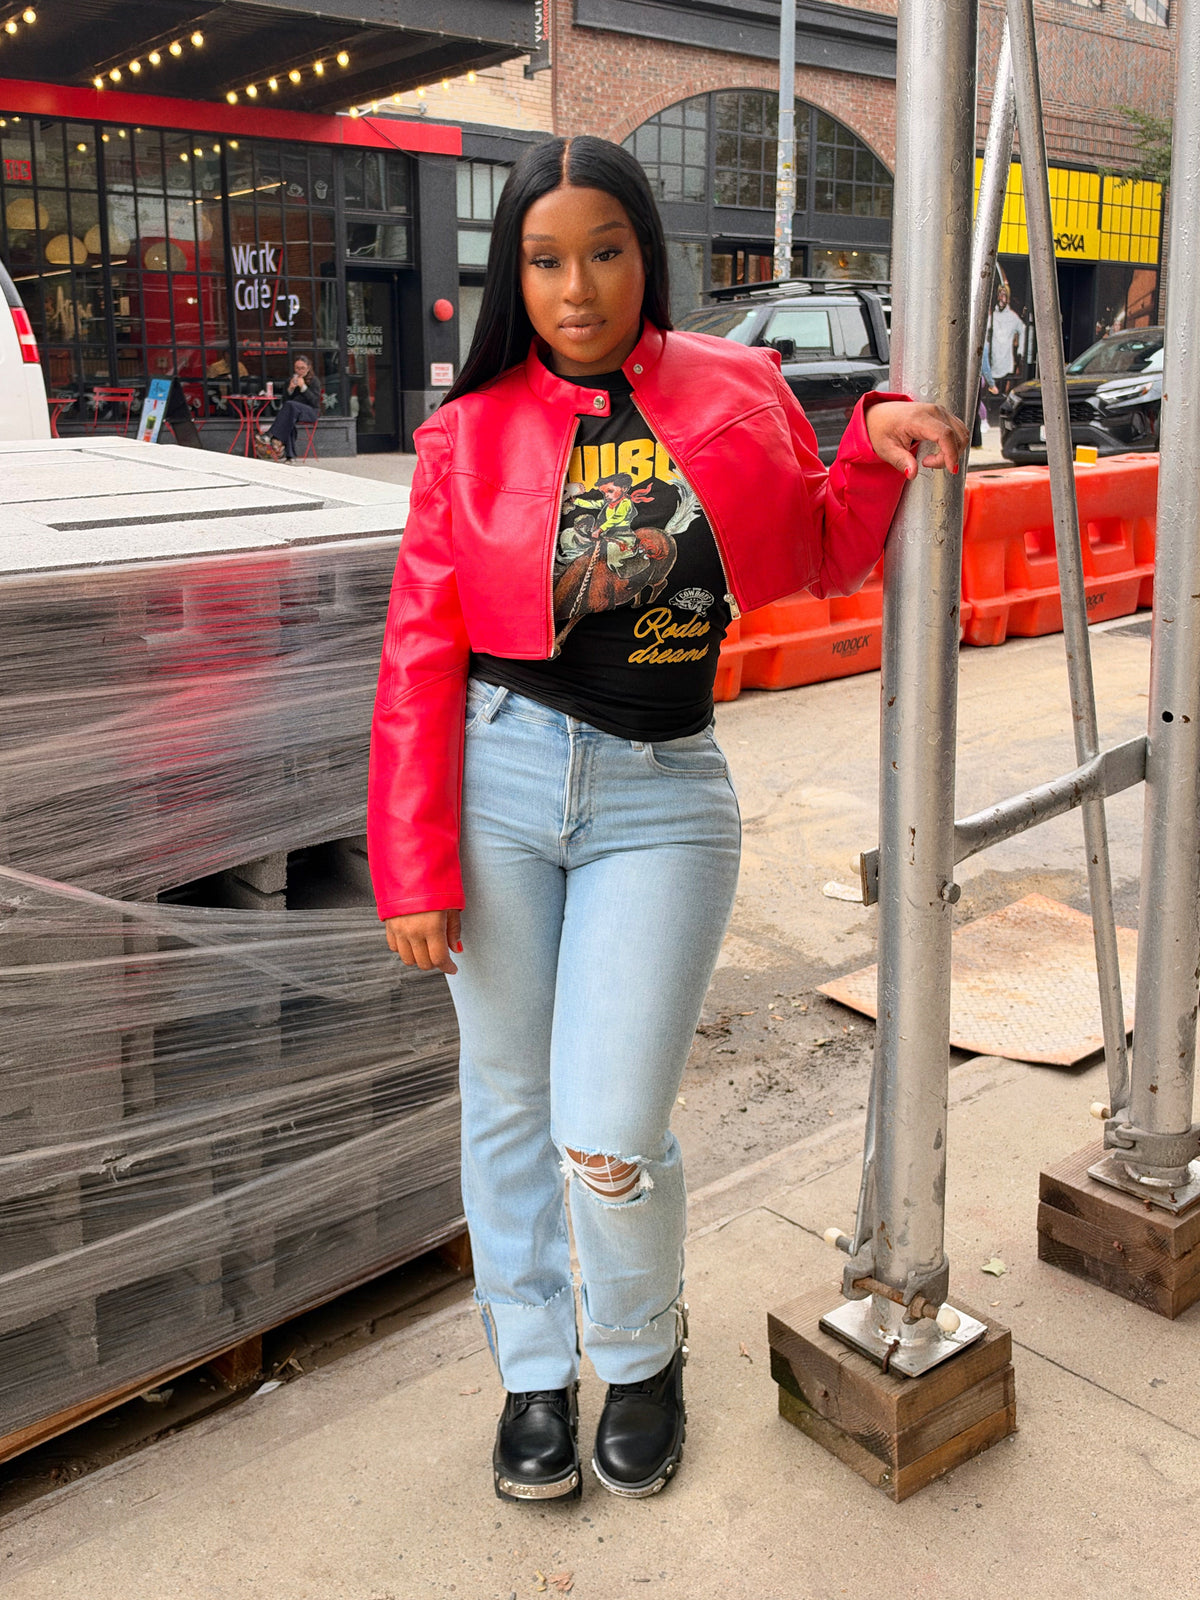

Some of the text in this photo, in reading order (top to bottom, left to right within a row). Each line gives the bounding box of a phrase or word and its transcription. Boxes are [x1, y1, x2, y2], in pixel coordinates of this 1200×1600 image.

[369, 326, 383, 334] USE
[356, 334, 384, 346] MAIN
[346, 347, 383, 355] ENTRANCE
[633, 607, 711, 644] Rodeo
[832, 634, 871, 655] YODOCK
[628, 642, 710, 665] dreams
